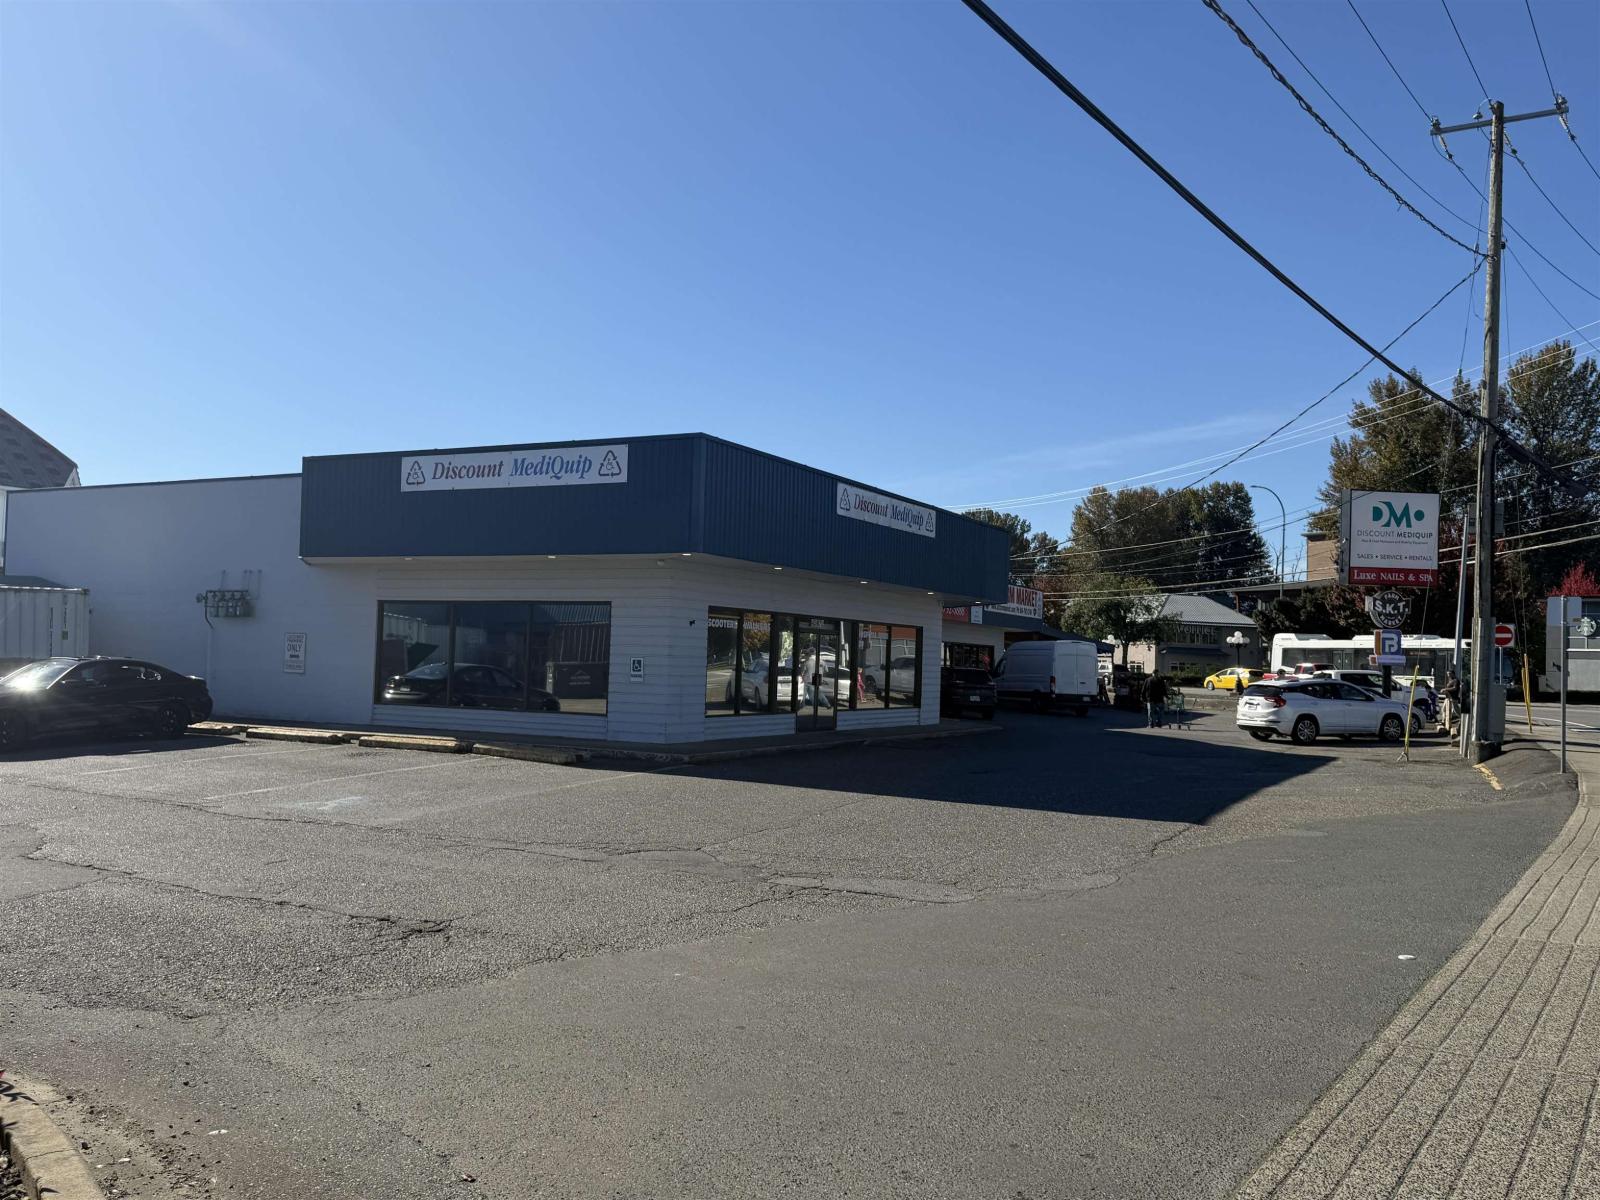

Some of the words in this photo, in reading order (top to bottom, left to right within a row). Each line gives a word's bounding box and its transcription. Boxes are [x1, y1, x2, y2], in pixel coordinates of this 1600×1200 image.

[432, 460, 504, 480] Discount
[509, 454, 593, 480] MediQuip
[853, 493, 888, 517] Discount
[890, 503, 924, 530] MediQuip
[1356, 529, 1395, 538] DISCOUNT
[1396, 531, 1433, 539] MEDIQUIP
[1354, 569, 1377, 580] Luxe
[1380, 573, 1405, 581] NAILS
[1408, 573, 1416, 581] &
[1419, 573, 1433, 582] SPA
[1016, 586, 1038, 608] MARKET
[1384, 592, 1400, 601] FARM
[1374, 600, 1409, 614] S.K.T.
[1380, 614, 1402, 626] MARKET
[287, 643, 303, 653] ONLY
